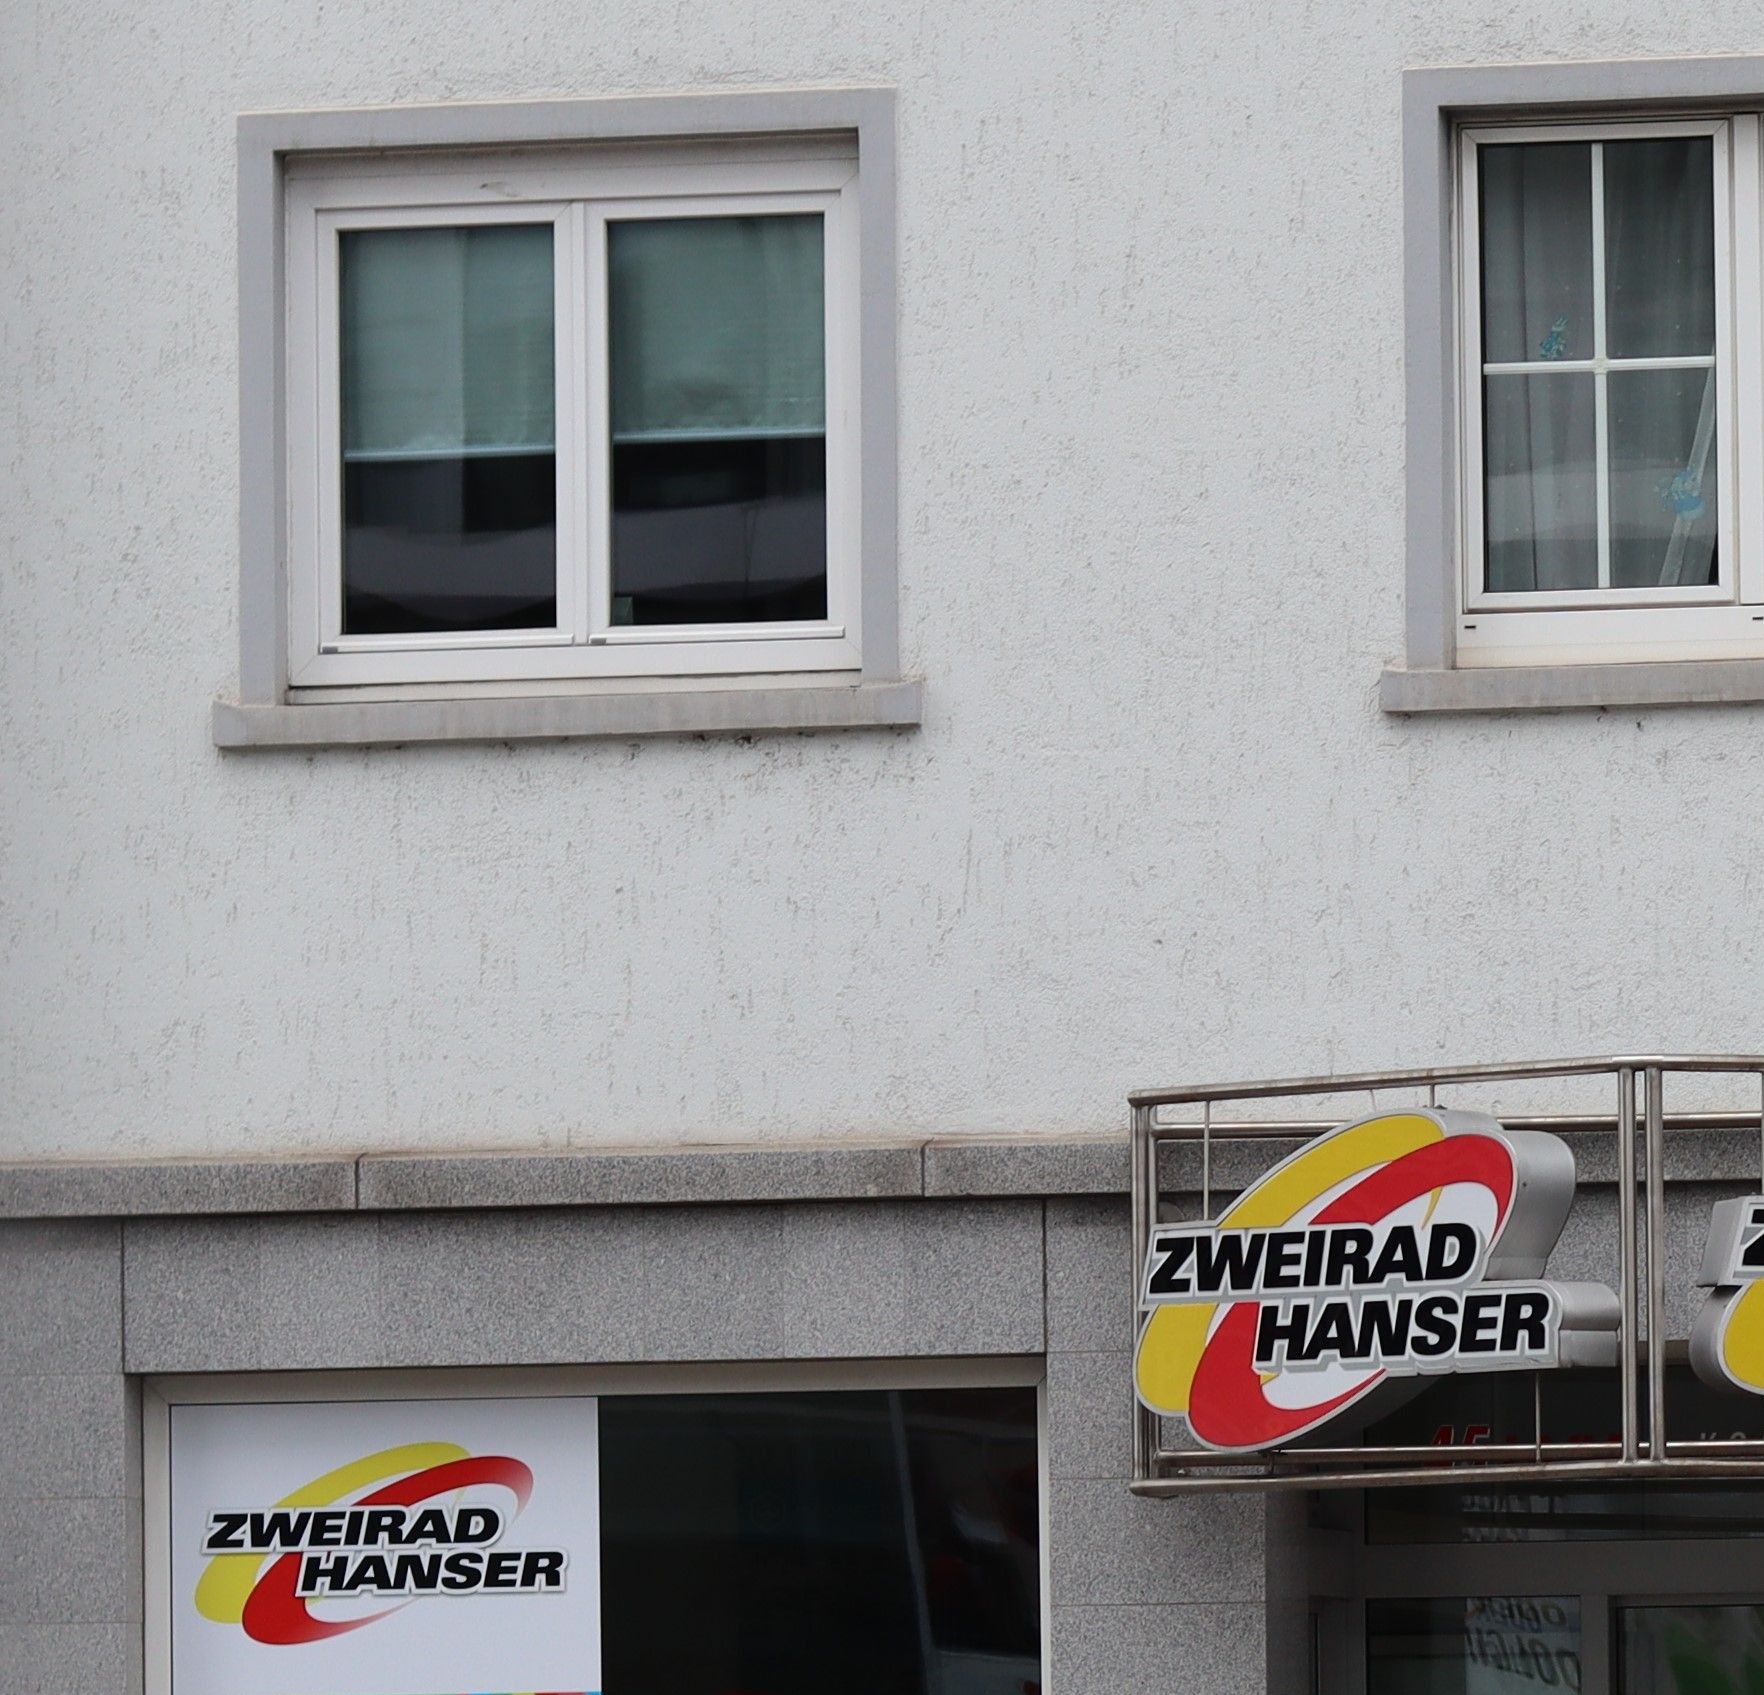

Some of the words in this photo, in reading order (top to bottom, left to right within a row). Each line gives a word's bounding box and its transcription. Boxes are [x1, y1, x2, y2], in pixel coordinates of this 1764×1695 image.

[1149, 1222, 1478, 1295] ZWEIRAD
[1254, 1291, 1550, 1366] HANSER
[206, 1508, 501, 1550] ZWEIRAD
[301, 1551, 565, 1591] HANSER
